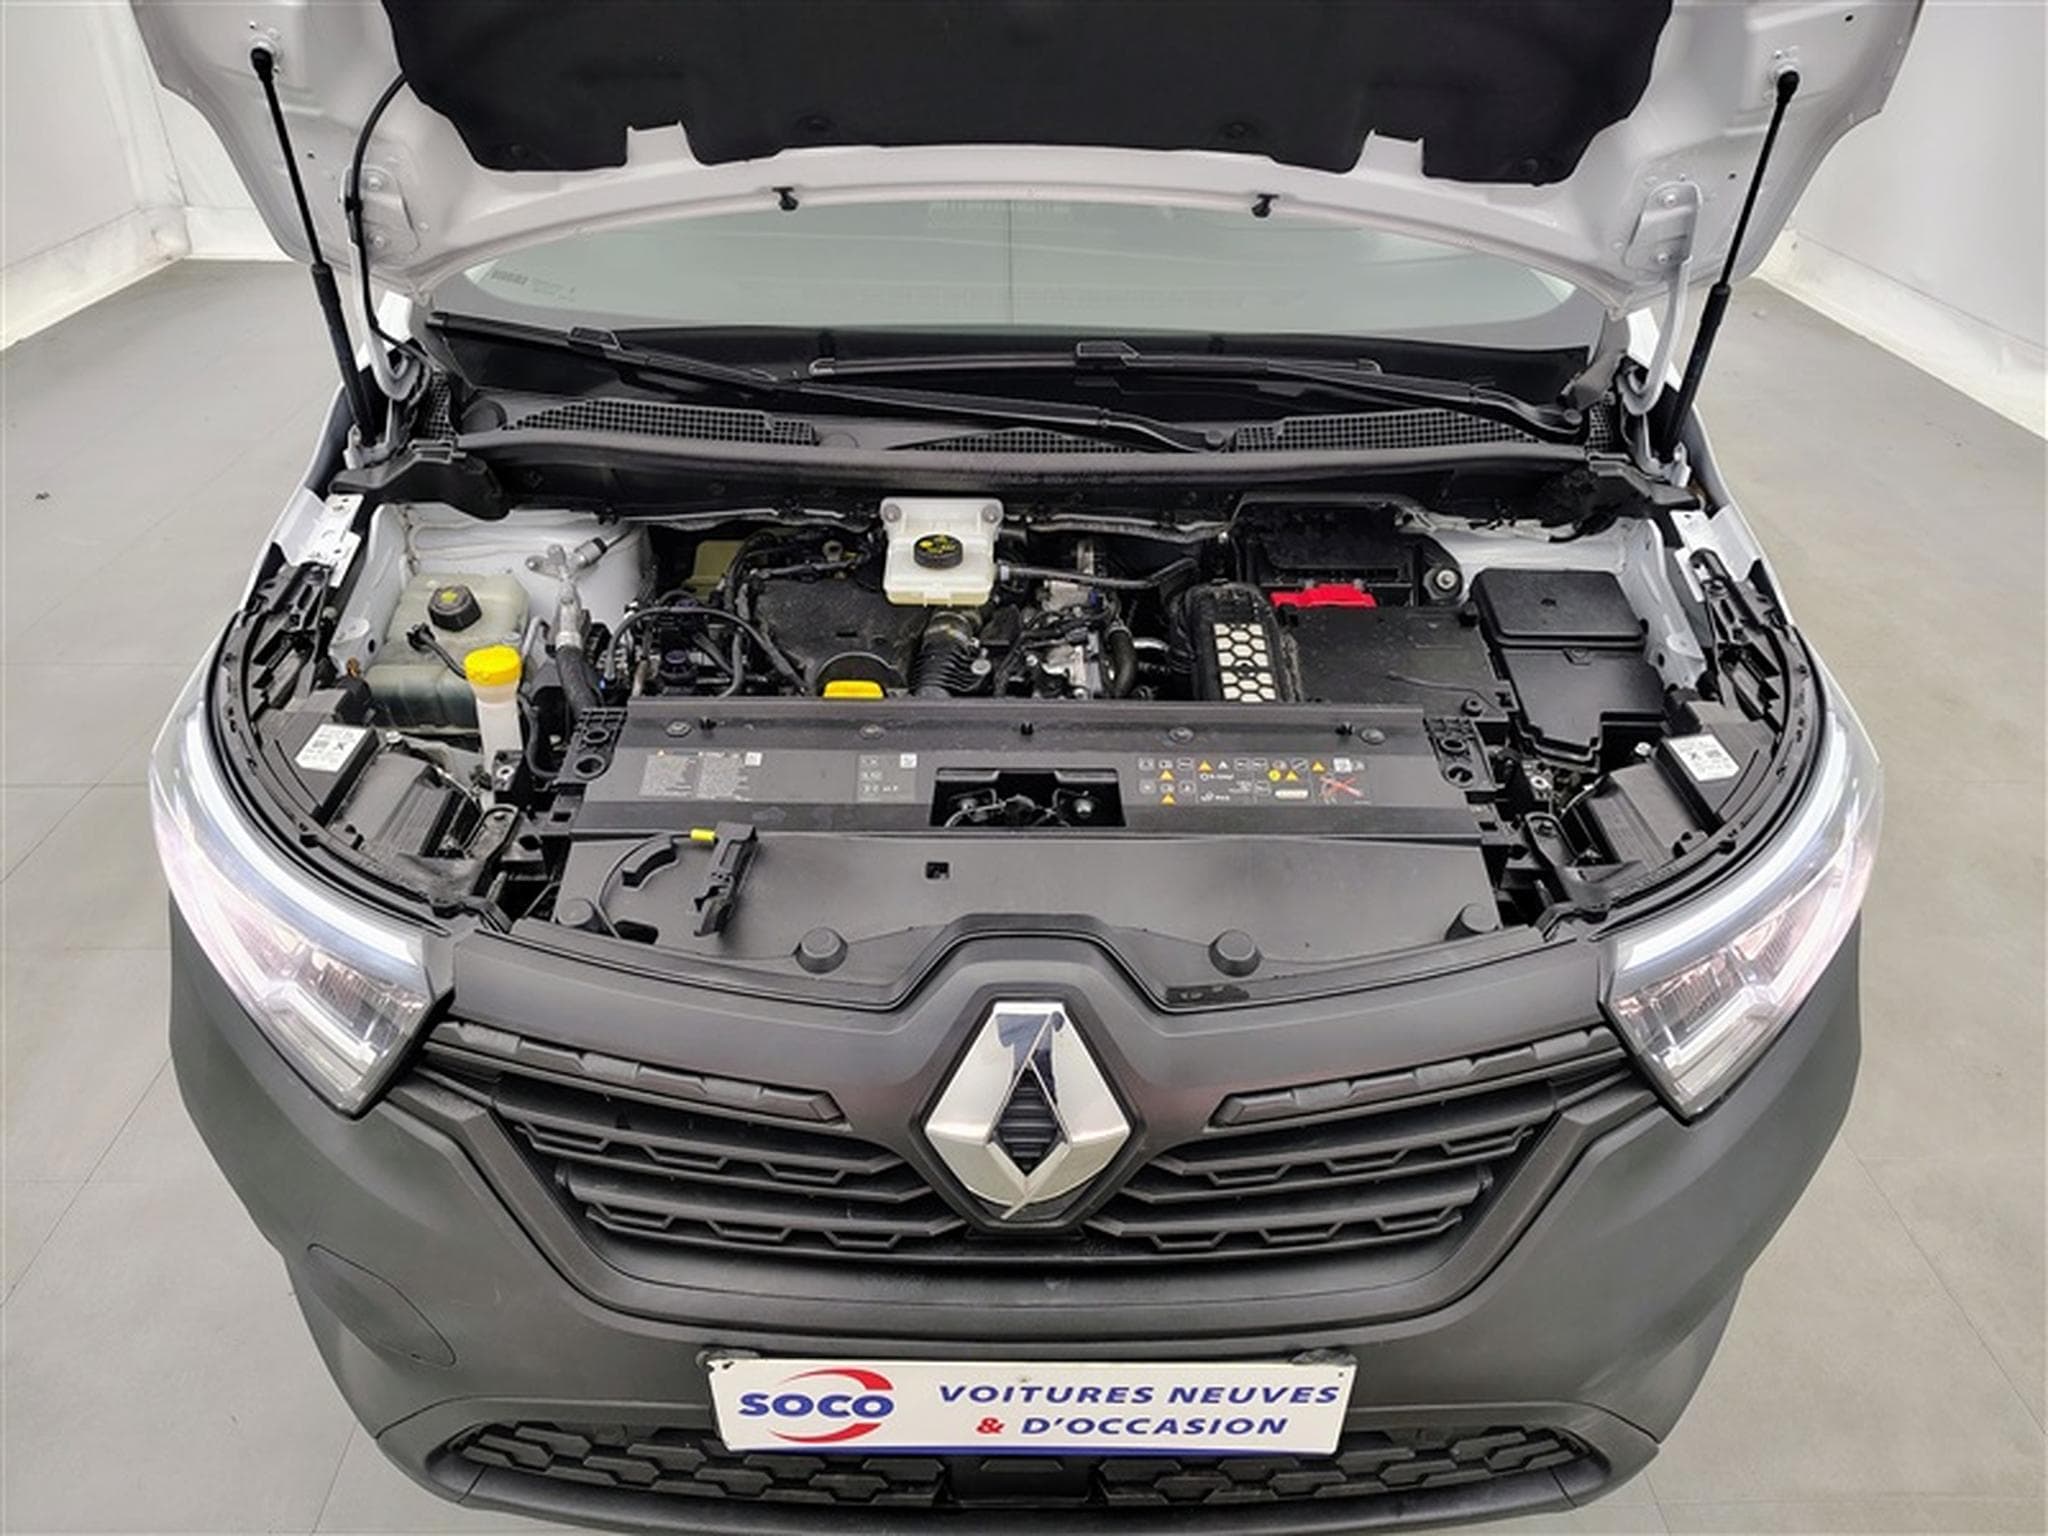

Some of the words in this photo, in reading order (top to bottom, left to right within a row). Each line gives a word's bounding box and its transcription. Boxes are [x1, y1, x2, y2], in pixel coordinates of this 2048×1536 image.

[939, 1385, 1155, 1404] VOITURES
[1167, 1386, 1340, 1404] NEUVES
[738, 1392, 895, 1419] SOCO
[976, 1416, 1006, 1435] &
[1021, 1417, 1288, 1435] D'OCCASION
